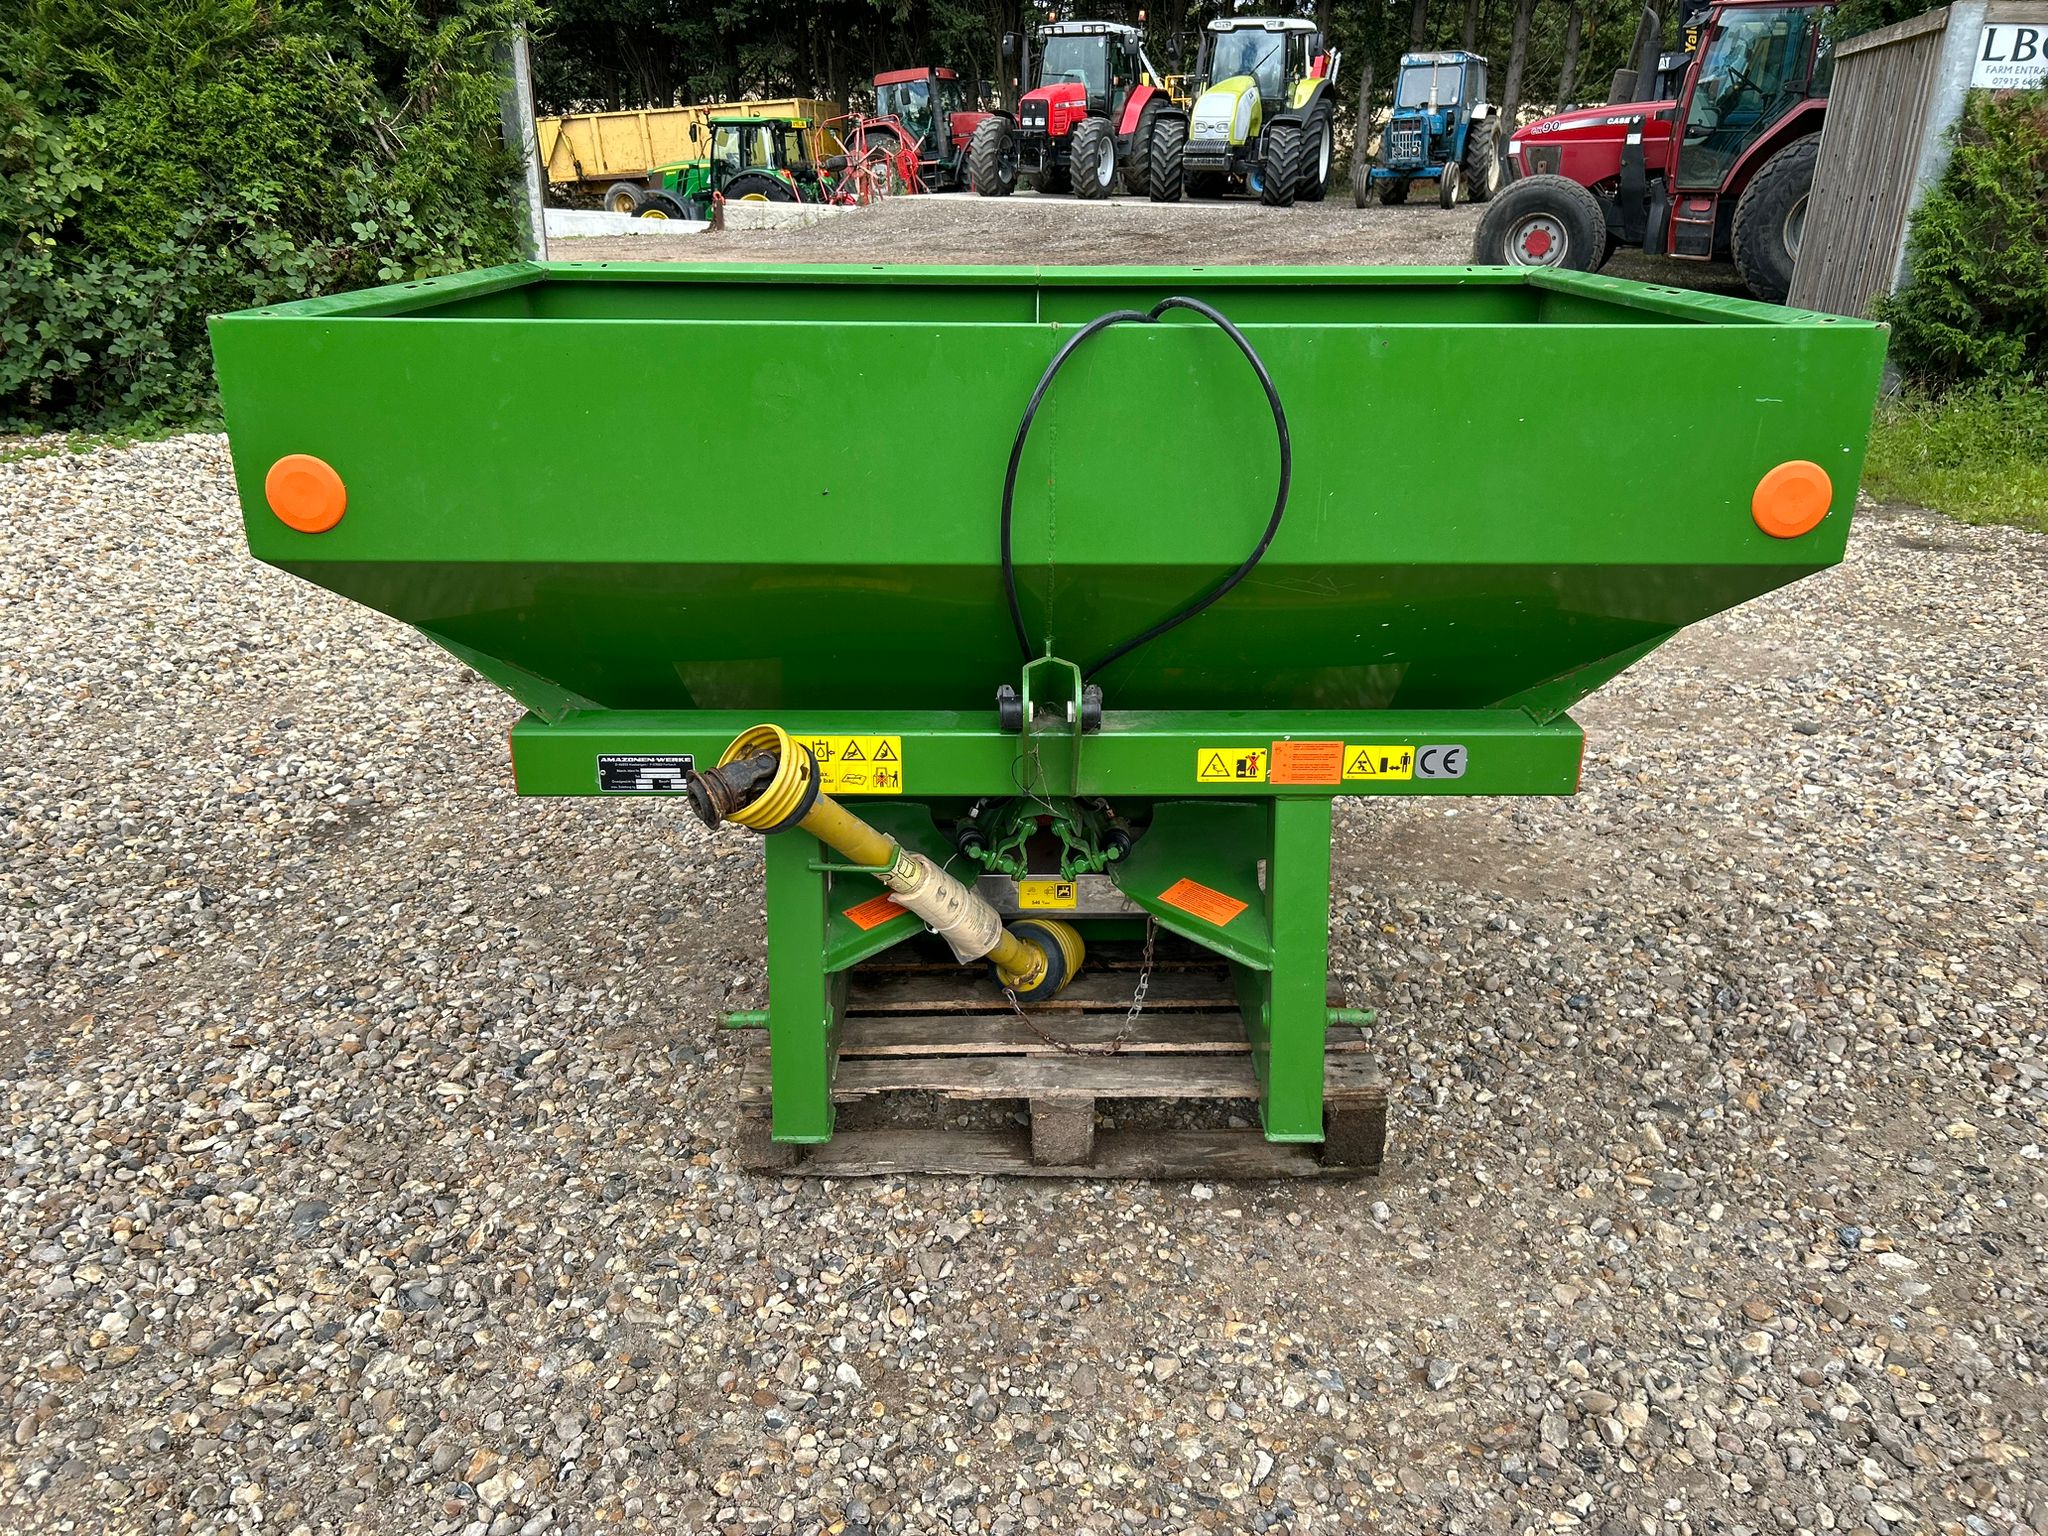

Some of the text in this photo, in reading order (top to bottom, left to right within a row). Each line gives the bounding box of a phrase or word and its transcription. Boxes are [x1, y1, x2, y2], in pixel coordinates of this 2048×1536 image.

[1682, 26, 1698, 53] Yal
[1658, 57, 1671, 71] AT
[1985, 65, 2048, 75] FARM ENTRA
[1992, 77, 2020, 87] 07915
[1607, 116, 1631, 125] CASE
